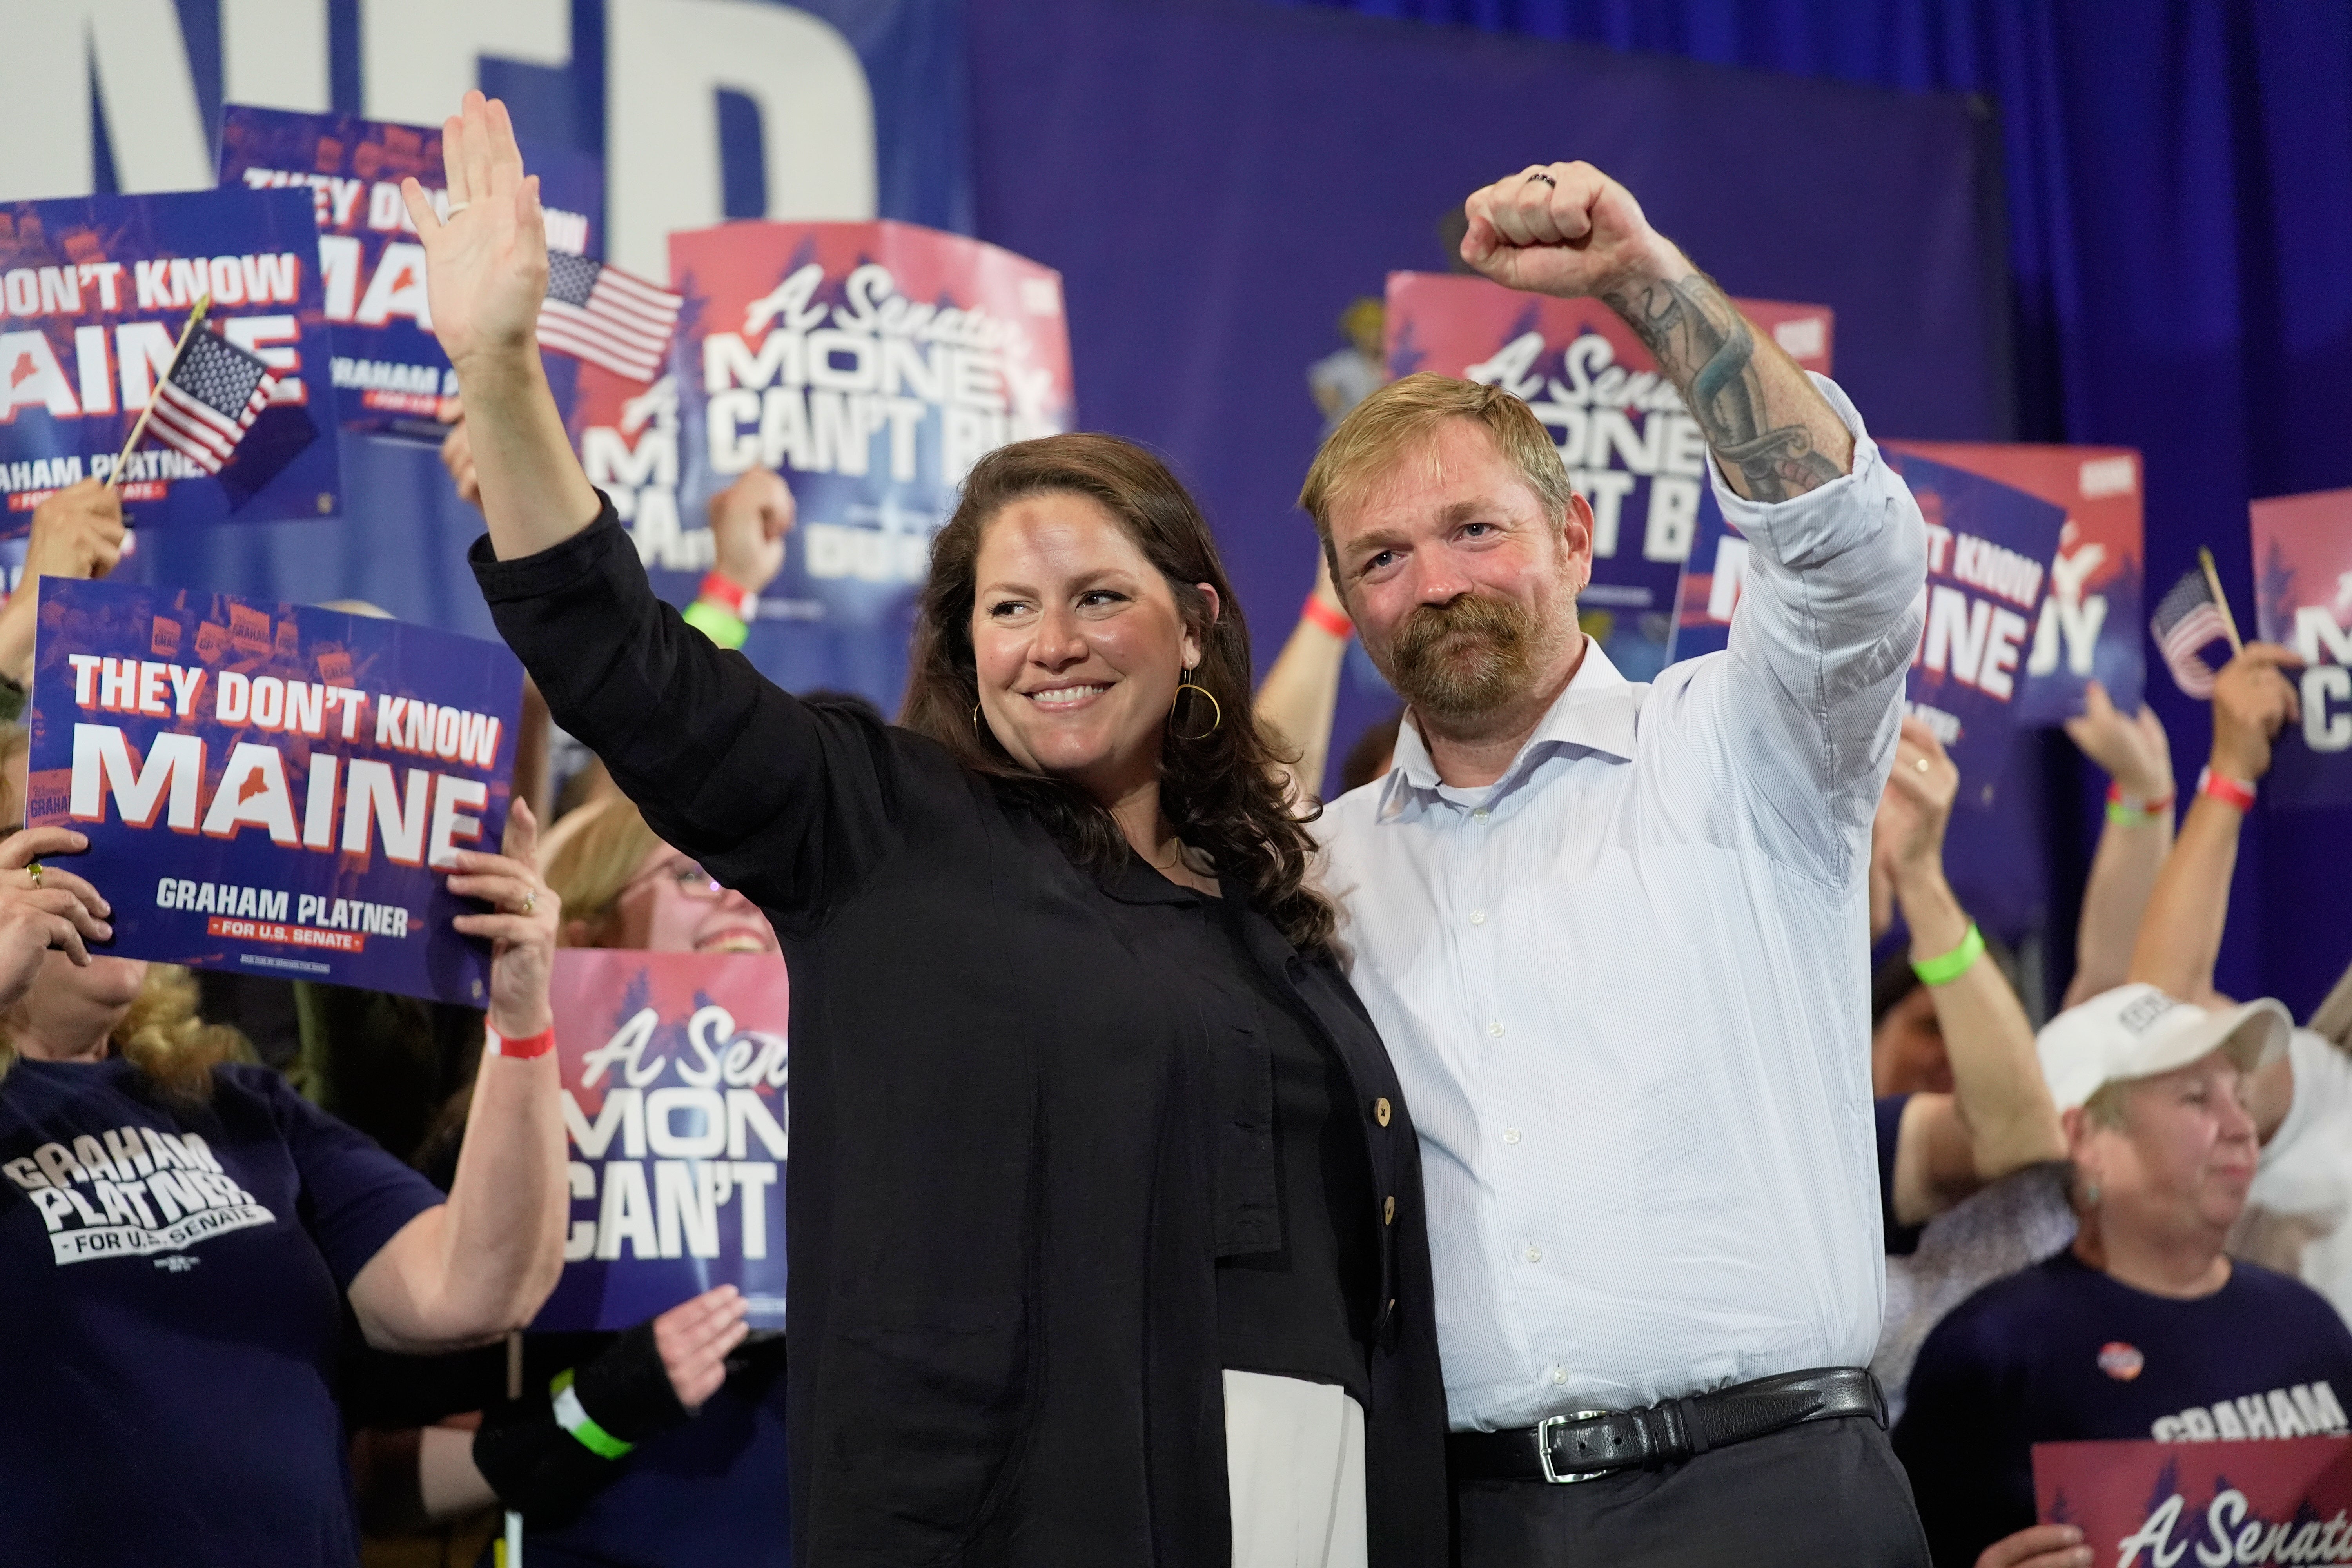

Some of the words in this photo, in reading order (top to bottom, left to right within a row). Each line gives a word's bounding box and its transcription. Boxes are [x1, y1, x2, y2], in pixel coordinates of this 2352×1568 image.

[0, 262, 121, 316] ON'T
[135, 253, 295, 309] KNOW
[744, 264, 828, 336] A
[329, 356, 440, 395] RAHAM
[703, 328, 1053, 423] MONEY
[706, 384, 927, 482] CAN'T
[1530, 401, 1704, 479] ONE
[69, 653, 205, 716] THEY
[216, 670, 367, 740] DON'T
[375, 692, 501, 765] KNOW
[30, 796, 70, 818] GRAHA
[69, 722, 486, 867] MAINE
[157, 877, 289, 922] GRAHAM
[297, 894, 409, 939] PLATNER
[222, 920, 255, 938] FOR
[259, 925, 288, 942] U.S.
[293, 929, 352, 950] SENATE
[581, 1007, 666, 1088] A
[1, 1126, 224, 1189] GRAHAM
[29, 1169, 257, 1232] PLATNER
[75, 1234, 121, 1252] FOR
[171, 1207, 258, 1244] SENATE
[2119, 1493, 2189, 1568] A
